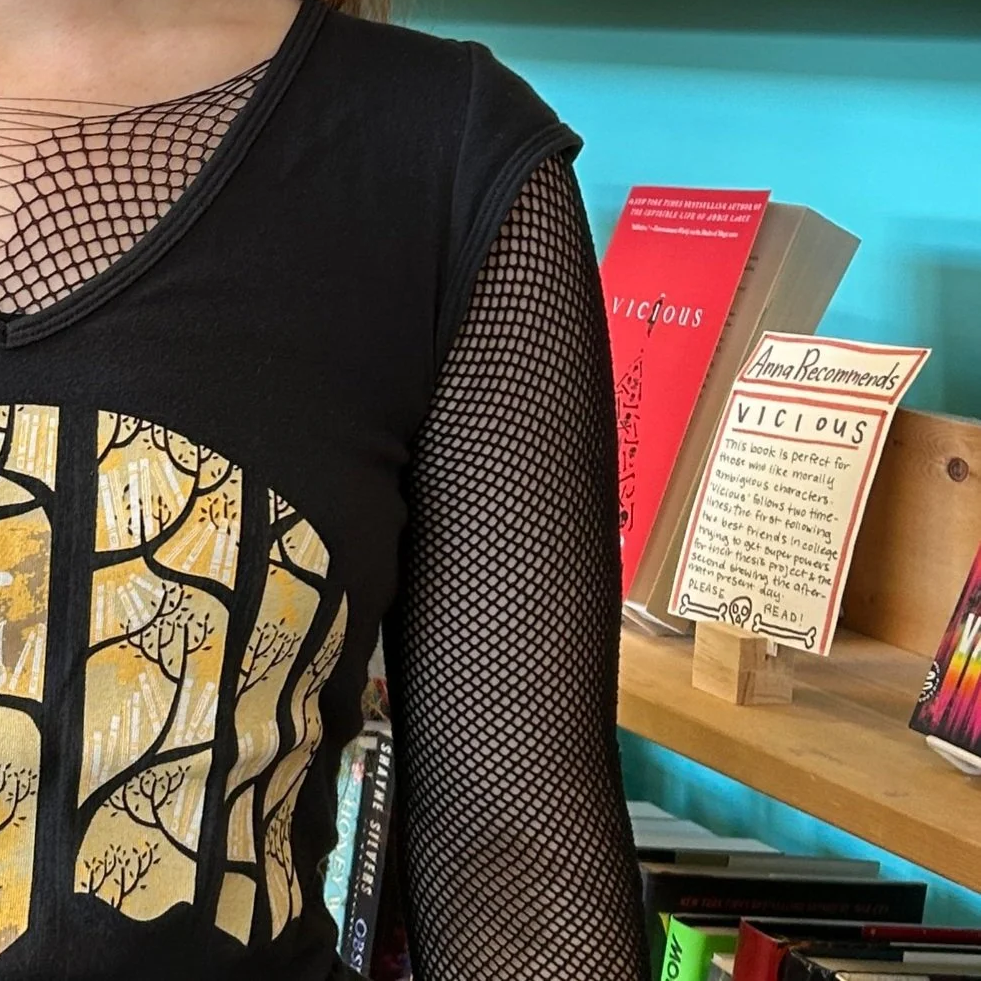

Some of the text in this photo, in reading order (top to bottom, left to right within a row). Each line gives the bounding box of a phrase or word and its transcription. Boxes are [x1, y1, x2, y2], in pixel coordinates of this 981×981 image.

[612, 293, 703, 328] VICIOUS
[747, 345, 900, 390] Anna Recommends
[719, 452, 835, 490] those who like morally
[725, 438, 851, 471] This book is perfect for
[715, 468, 769, 490] ambiguous
[752, 493, 785, 512] follows
[787, 506, 807, 518] two
[698, 525, 730, 545] trying
[732, 535, 742, 546] to
[744, 539, 762, 552] get
[721, 516, 744, 531] best
[746, 525, 788, 544] friends
[790, 536, 801, 547] in
[801, 541, 839, 560] college
[732, 503, 832, 544] the first following
[691, 552, 726, 570] second
[773, 576, 791, 589] the
[693, 537, 707, 550] for
[735, 550, 766, 566] thesis
[768, 562, 809, 578] project
[688, 578, 726, 599] PLEASE
[716, 572, 755, 590] present
[763, 603, 804, 626] READ!
[360, 742, 393, 896] SHAYNE SILVERS
